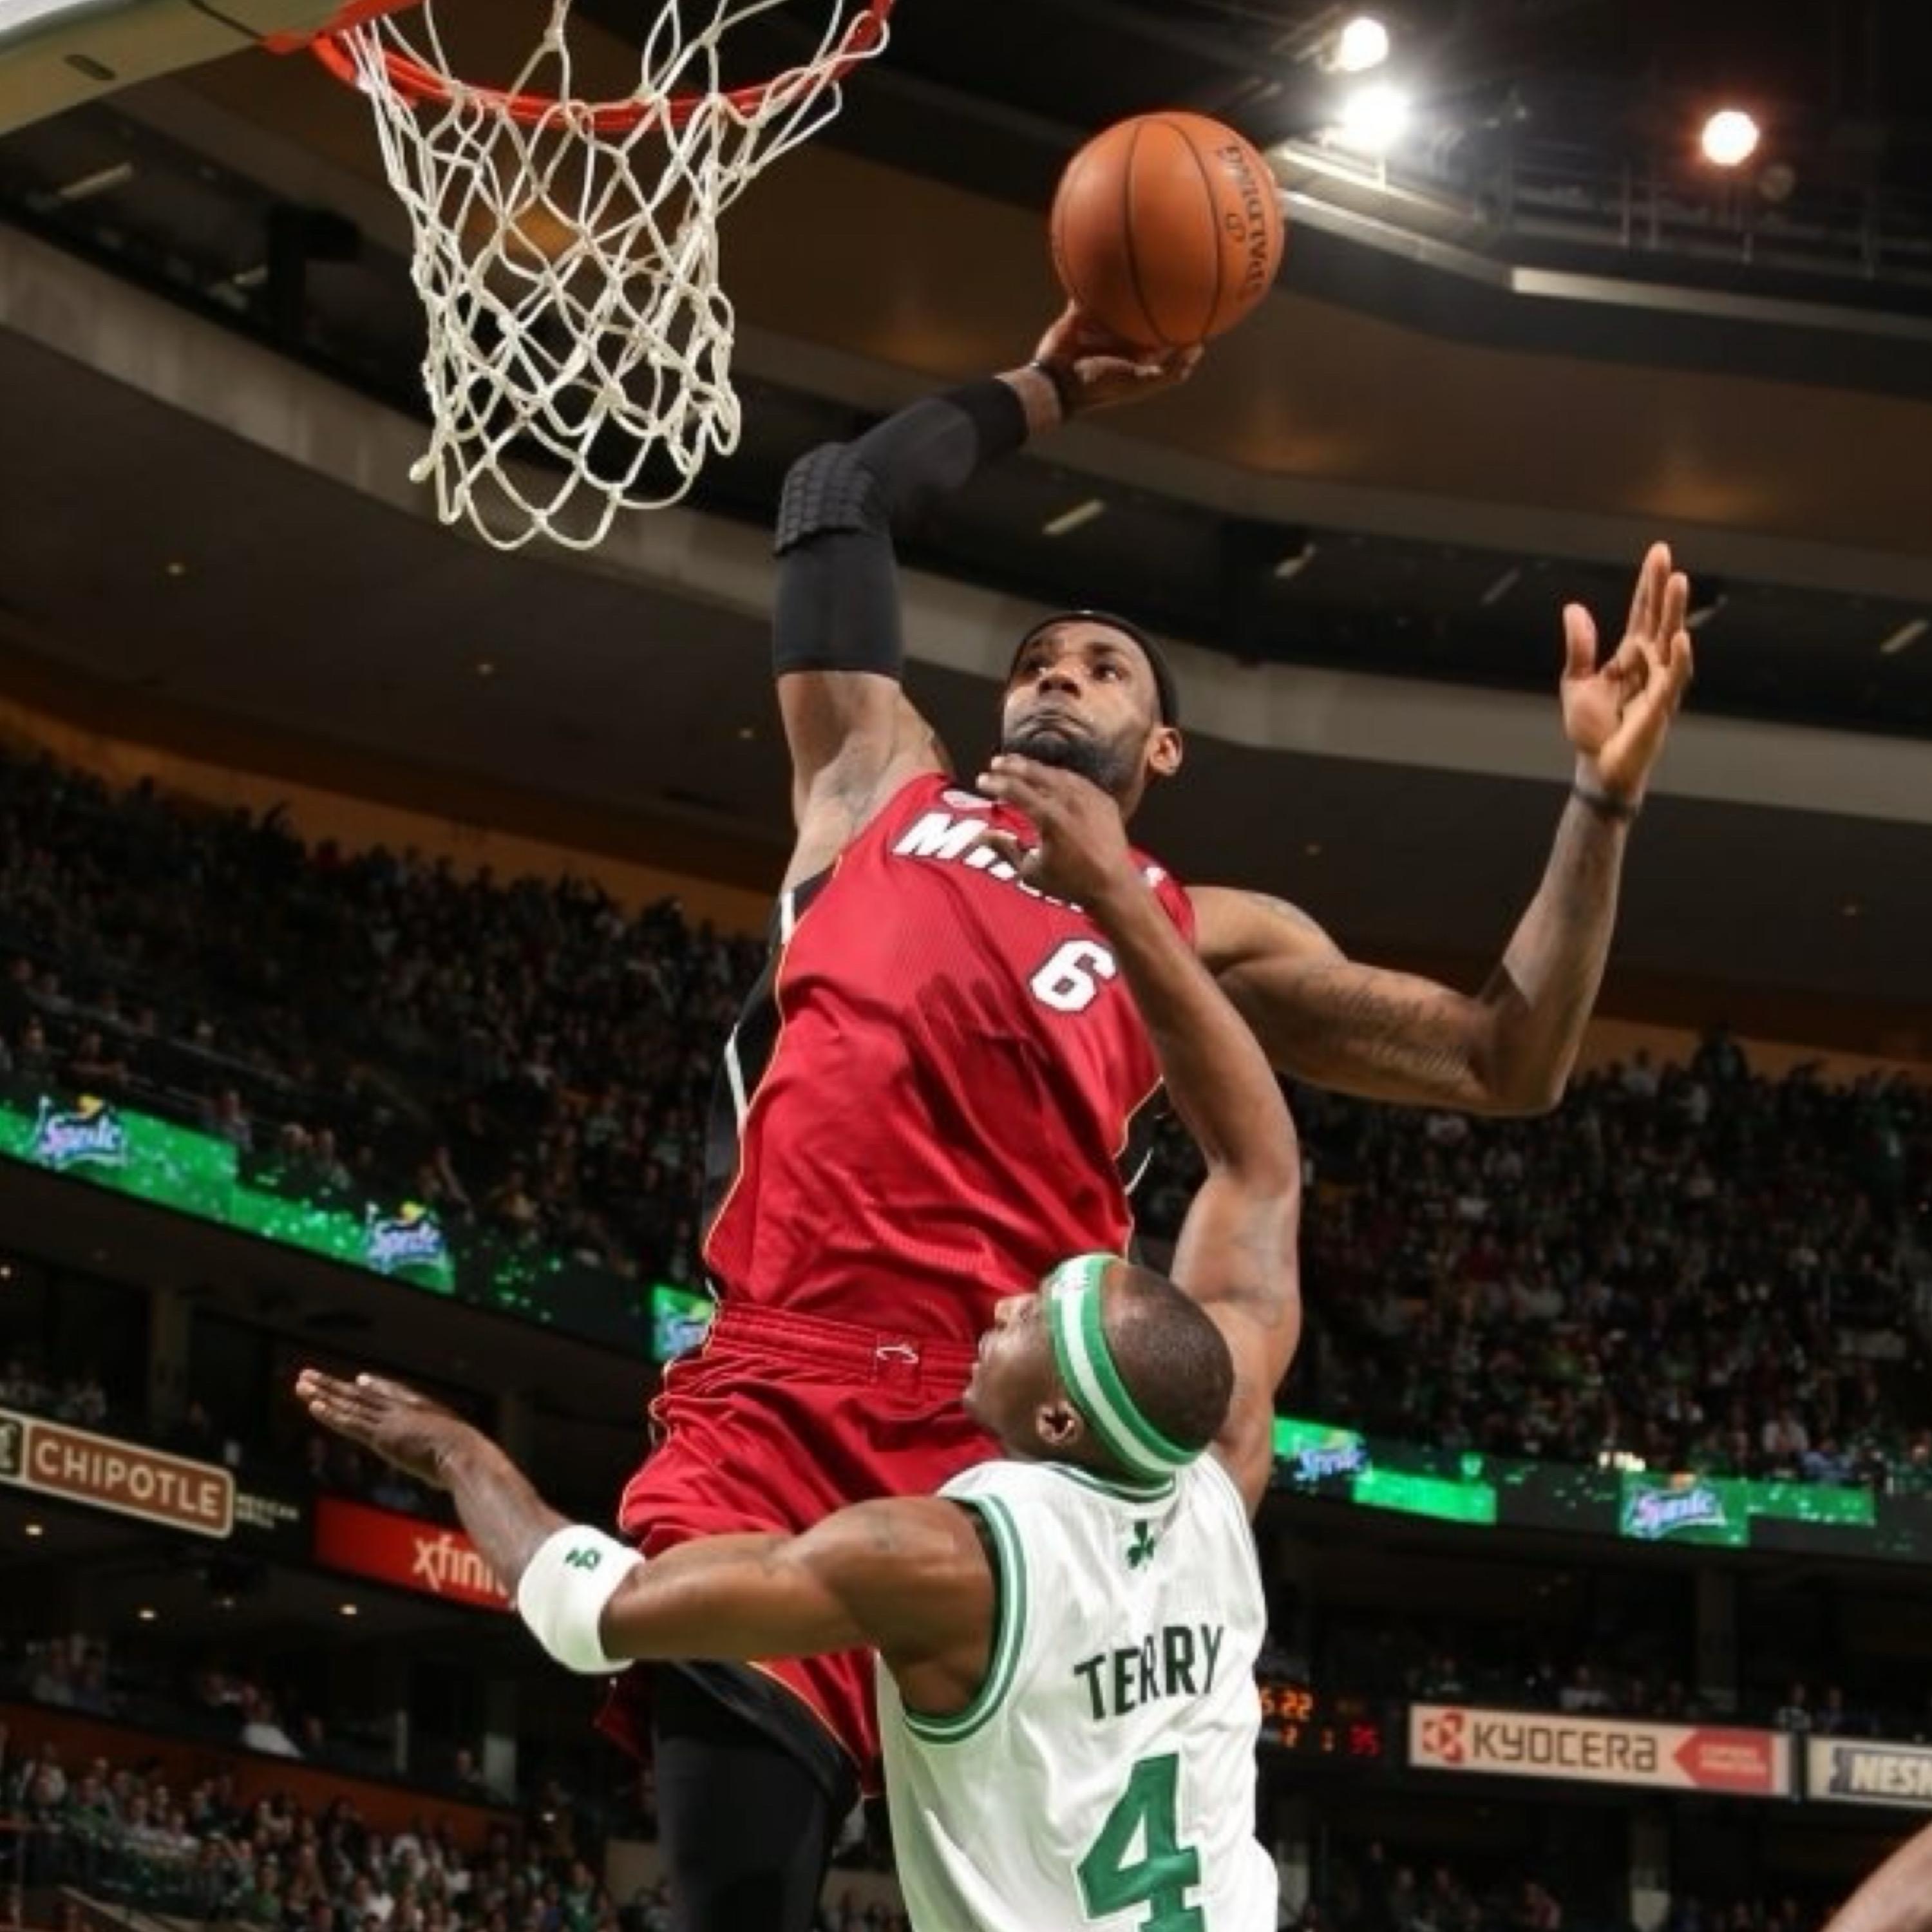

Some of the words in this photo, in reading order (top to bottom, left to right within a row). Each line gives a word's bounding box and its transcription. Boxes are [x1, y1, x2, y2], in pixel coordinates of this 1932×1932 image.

[1030, 938, 1118, 1014] 6
[35, 1439, 220, 1517] CHIPOTLE
[1073, 1623, 1225, 1719] TERRY
[1076, 1752, 1208, 1932] 4
